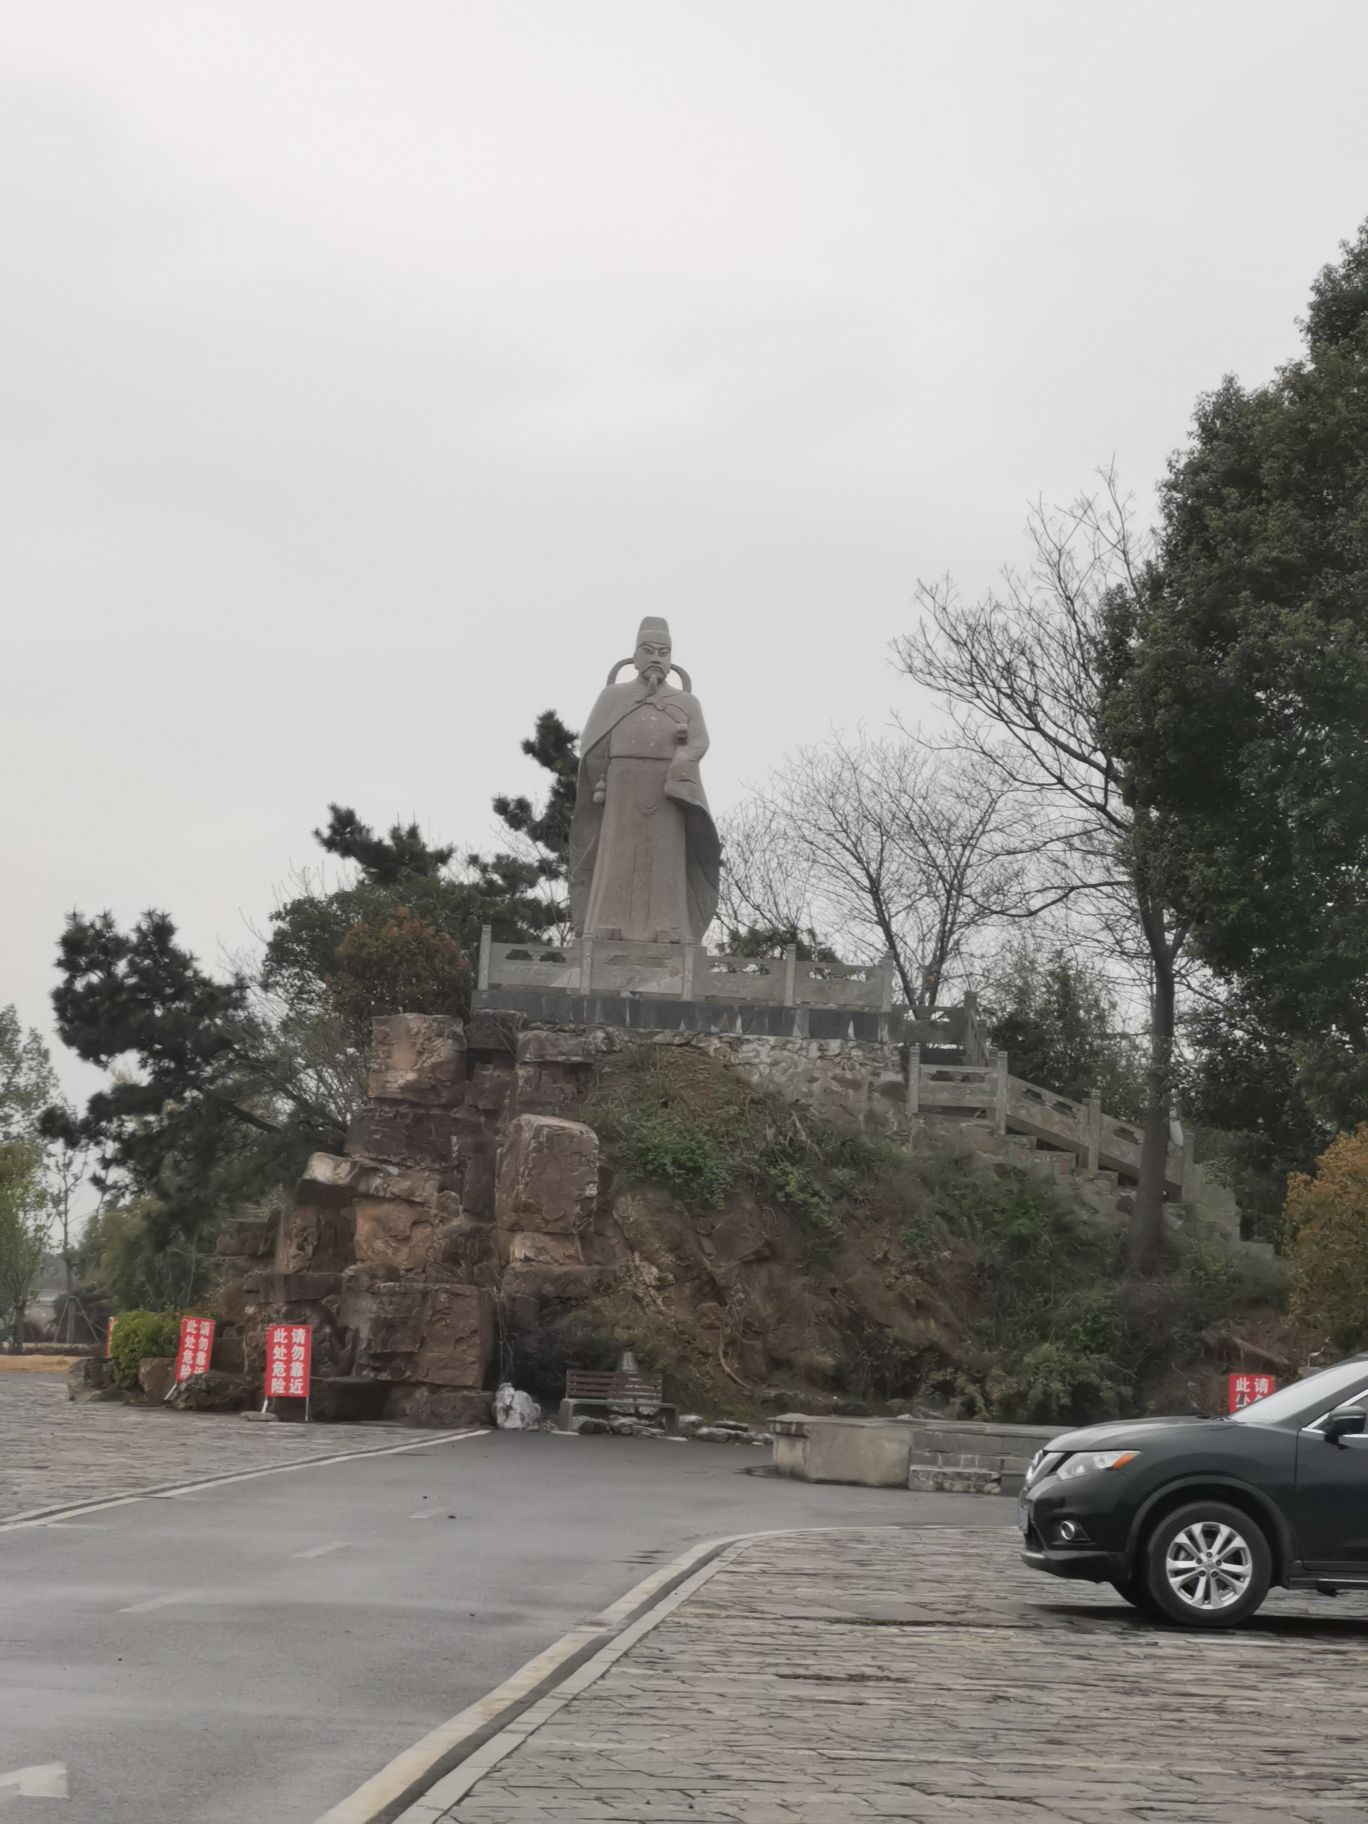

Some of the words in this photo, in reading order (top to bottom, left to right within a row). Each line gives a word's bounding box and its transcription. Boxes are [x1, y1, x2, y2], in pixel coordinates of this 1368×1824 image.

[272, 1328, 287, 1394] 此处危险
[289, 1328, 305, 1394] 请勿靠近
